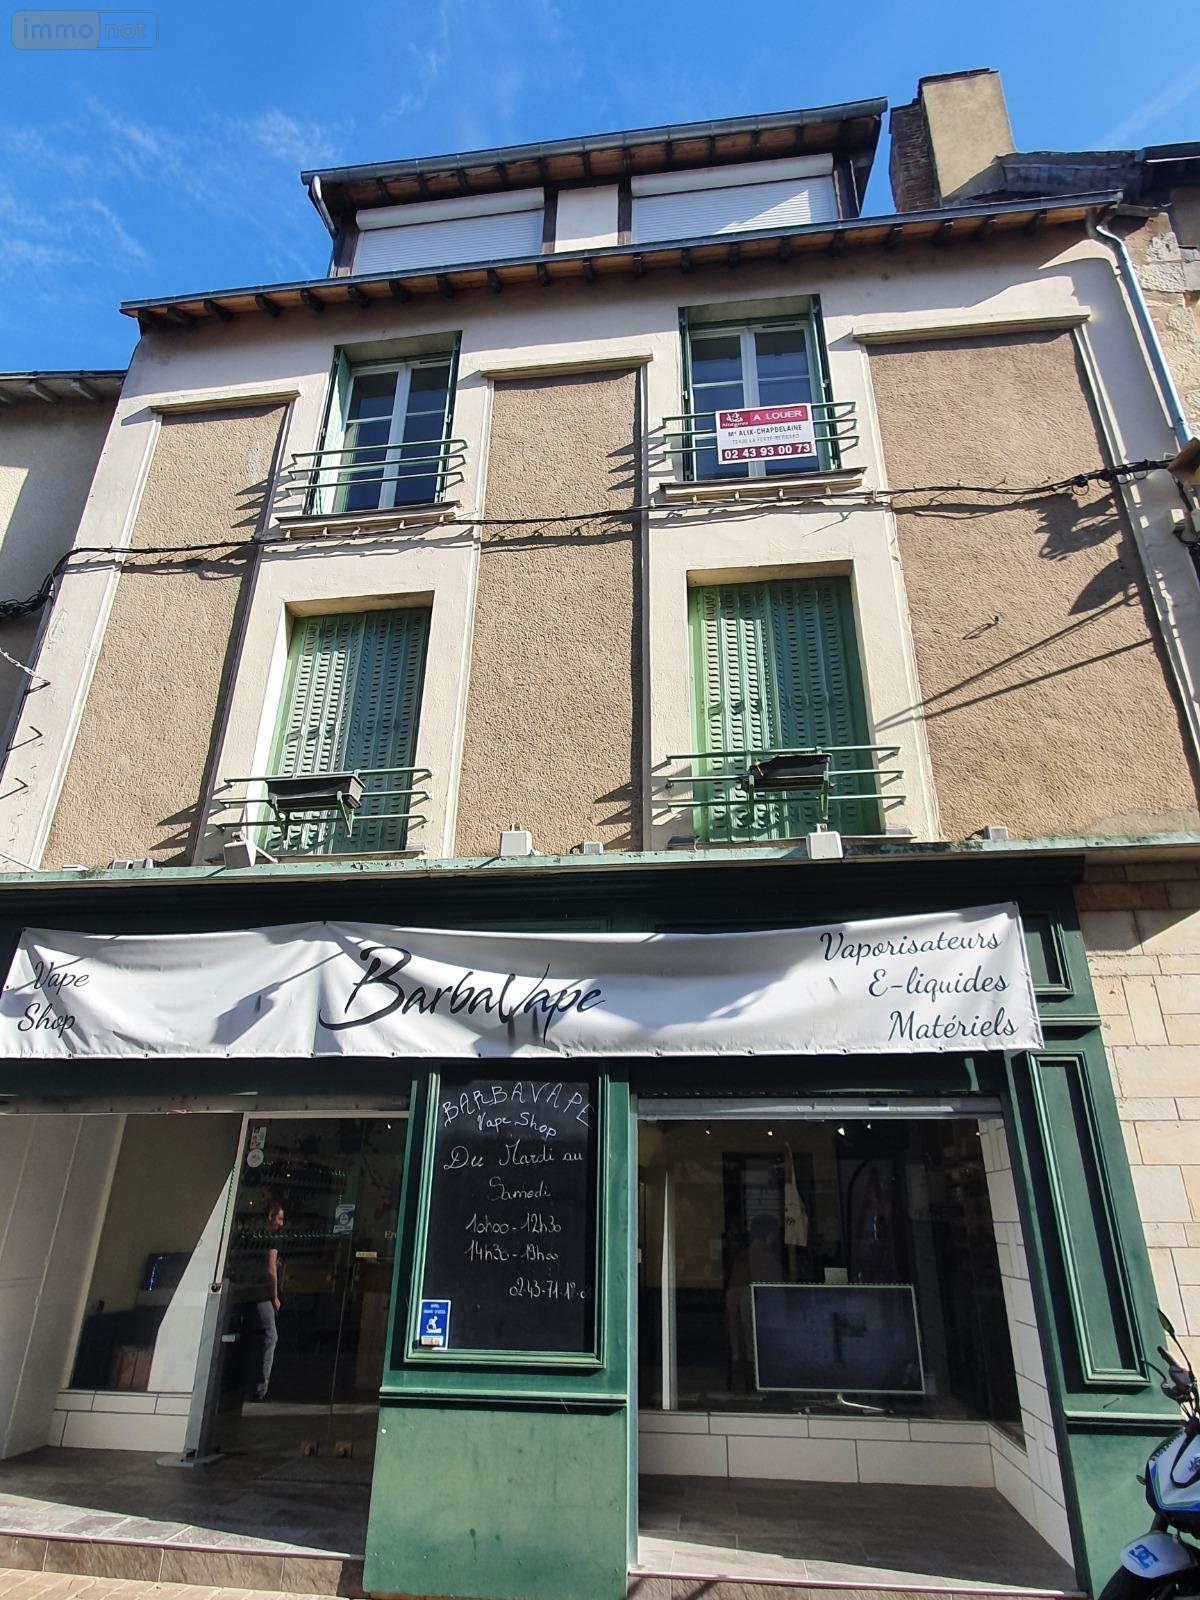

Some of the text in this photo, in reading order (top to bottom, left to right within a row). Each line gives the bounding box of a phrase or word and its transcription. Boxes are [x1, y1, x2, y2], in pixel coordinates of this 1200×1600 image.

[739, 424, 802, 436] ALIX-CHAPDELAINE
[753, 410, 802, 421] A LOUER
[724, 443, 810, 460] 02 43 93 00 73
[819, 931, 1002, 966] Vaporisateurs
[33, 960, 90, 990] Vape
[868, 965, 1010, 1002] E-liquides
[318, 945, 607, 1045] BarbaVape
[17, 1002, 76, 1038] Shop
[887, 1007, 1018, 1042] Matériels
[442, 1082, 593, 1128] BARBAVAPE
[476, 1112, 557, 1138] Vape Shop
[443, 1139, 584, 1170] Du Mardi au
[489, 1176, 552, 1201] Samedi
